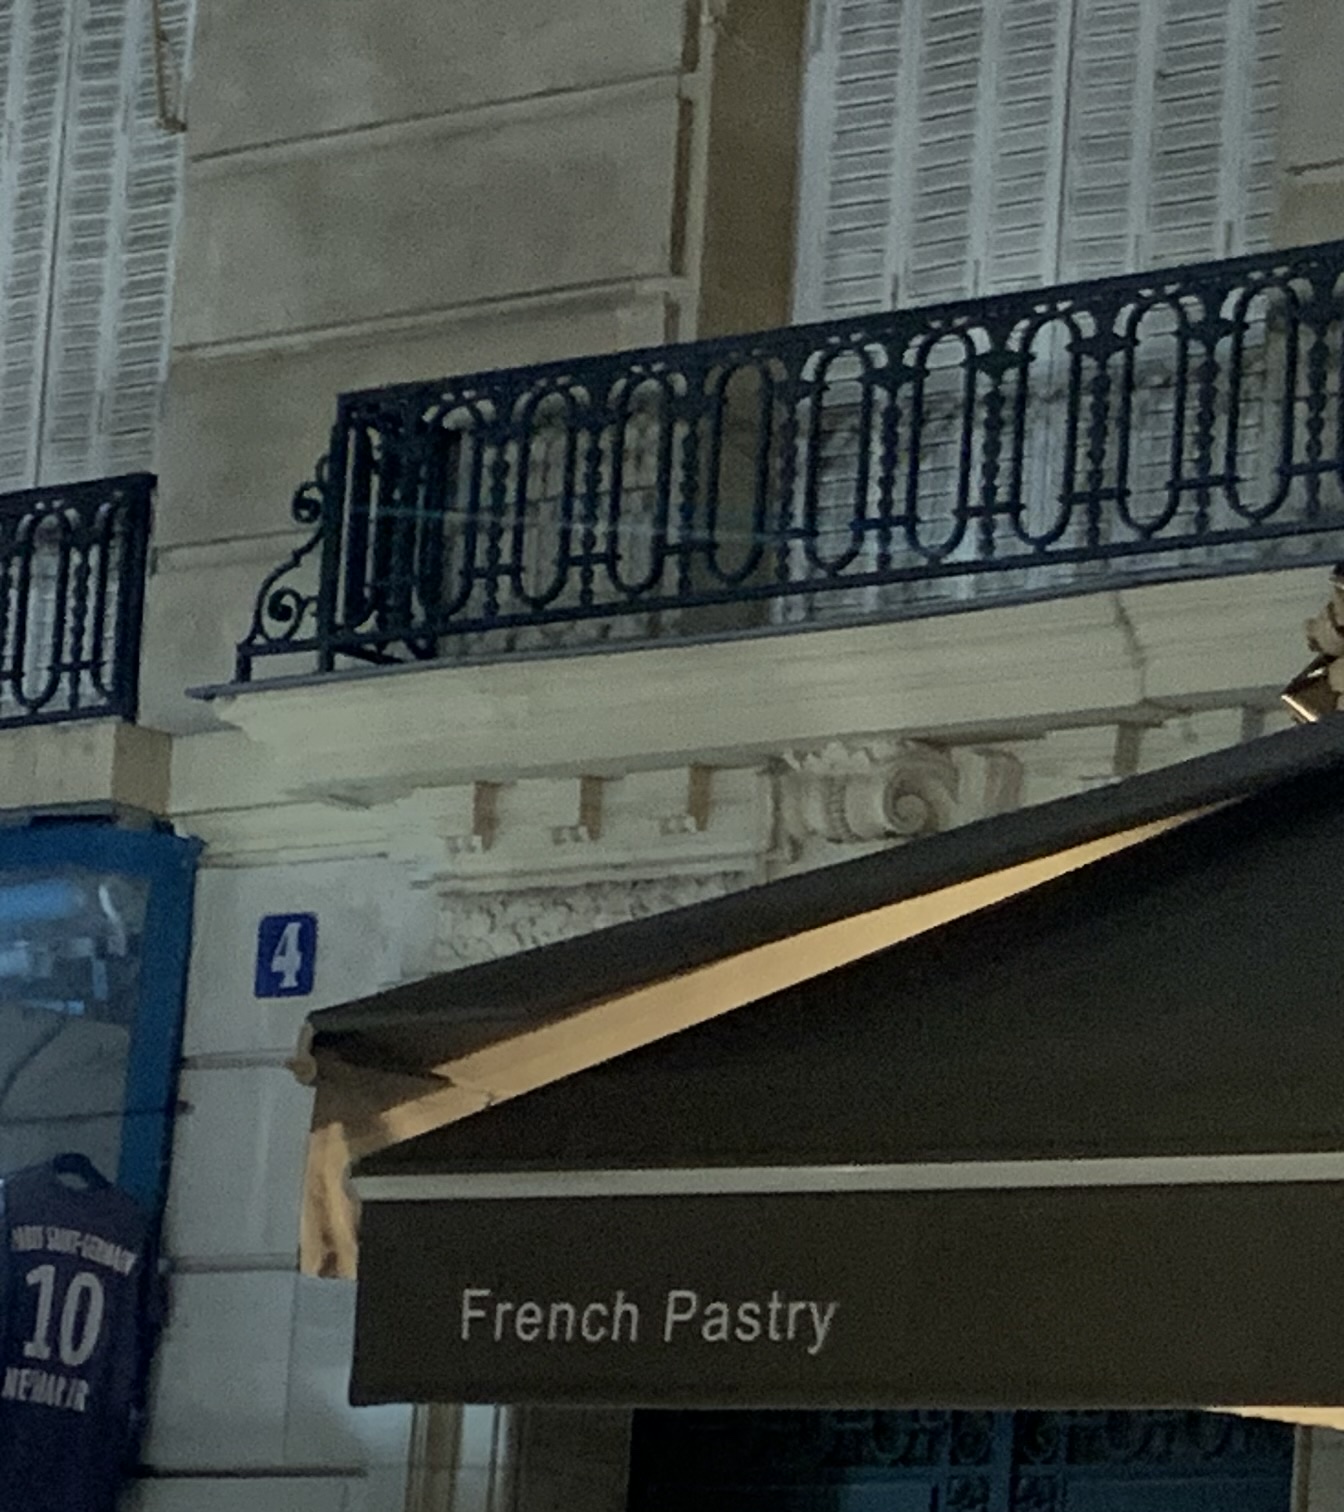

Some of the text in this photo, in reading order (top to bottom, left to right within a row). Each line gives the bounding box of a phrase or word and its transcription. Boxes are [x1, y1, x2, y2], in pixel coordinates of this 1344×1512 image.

[271, 921, 302, 989] 4
[22, 1263, 105, 1367] 10
[460, 1287, 838, 1355] French Pastry
